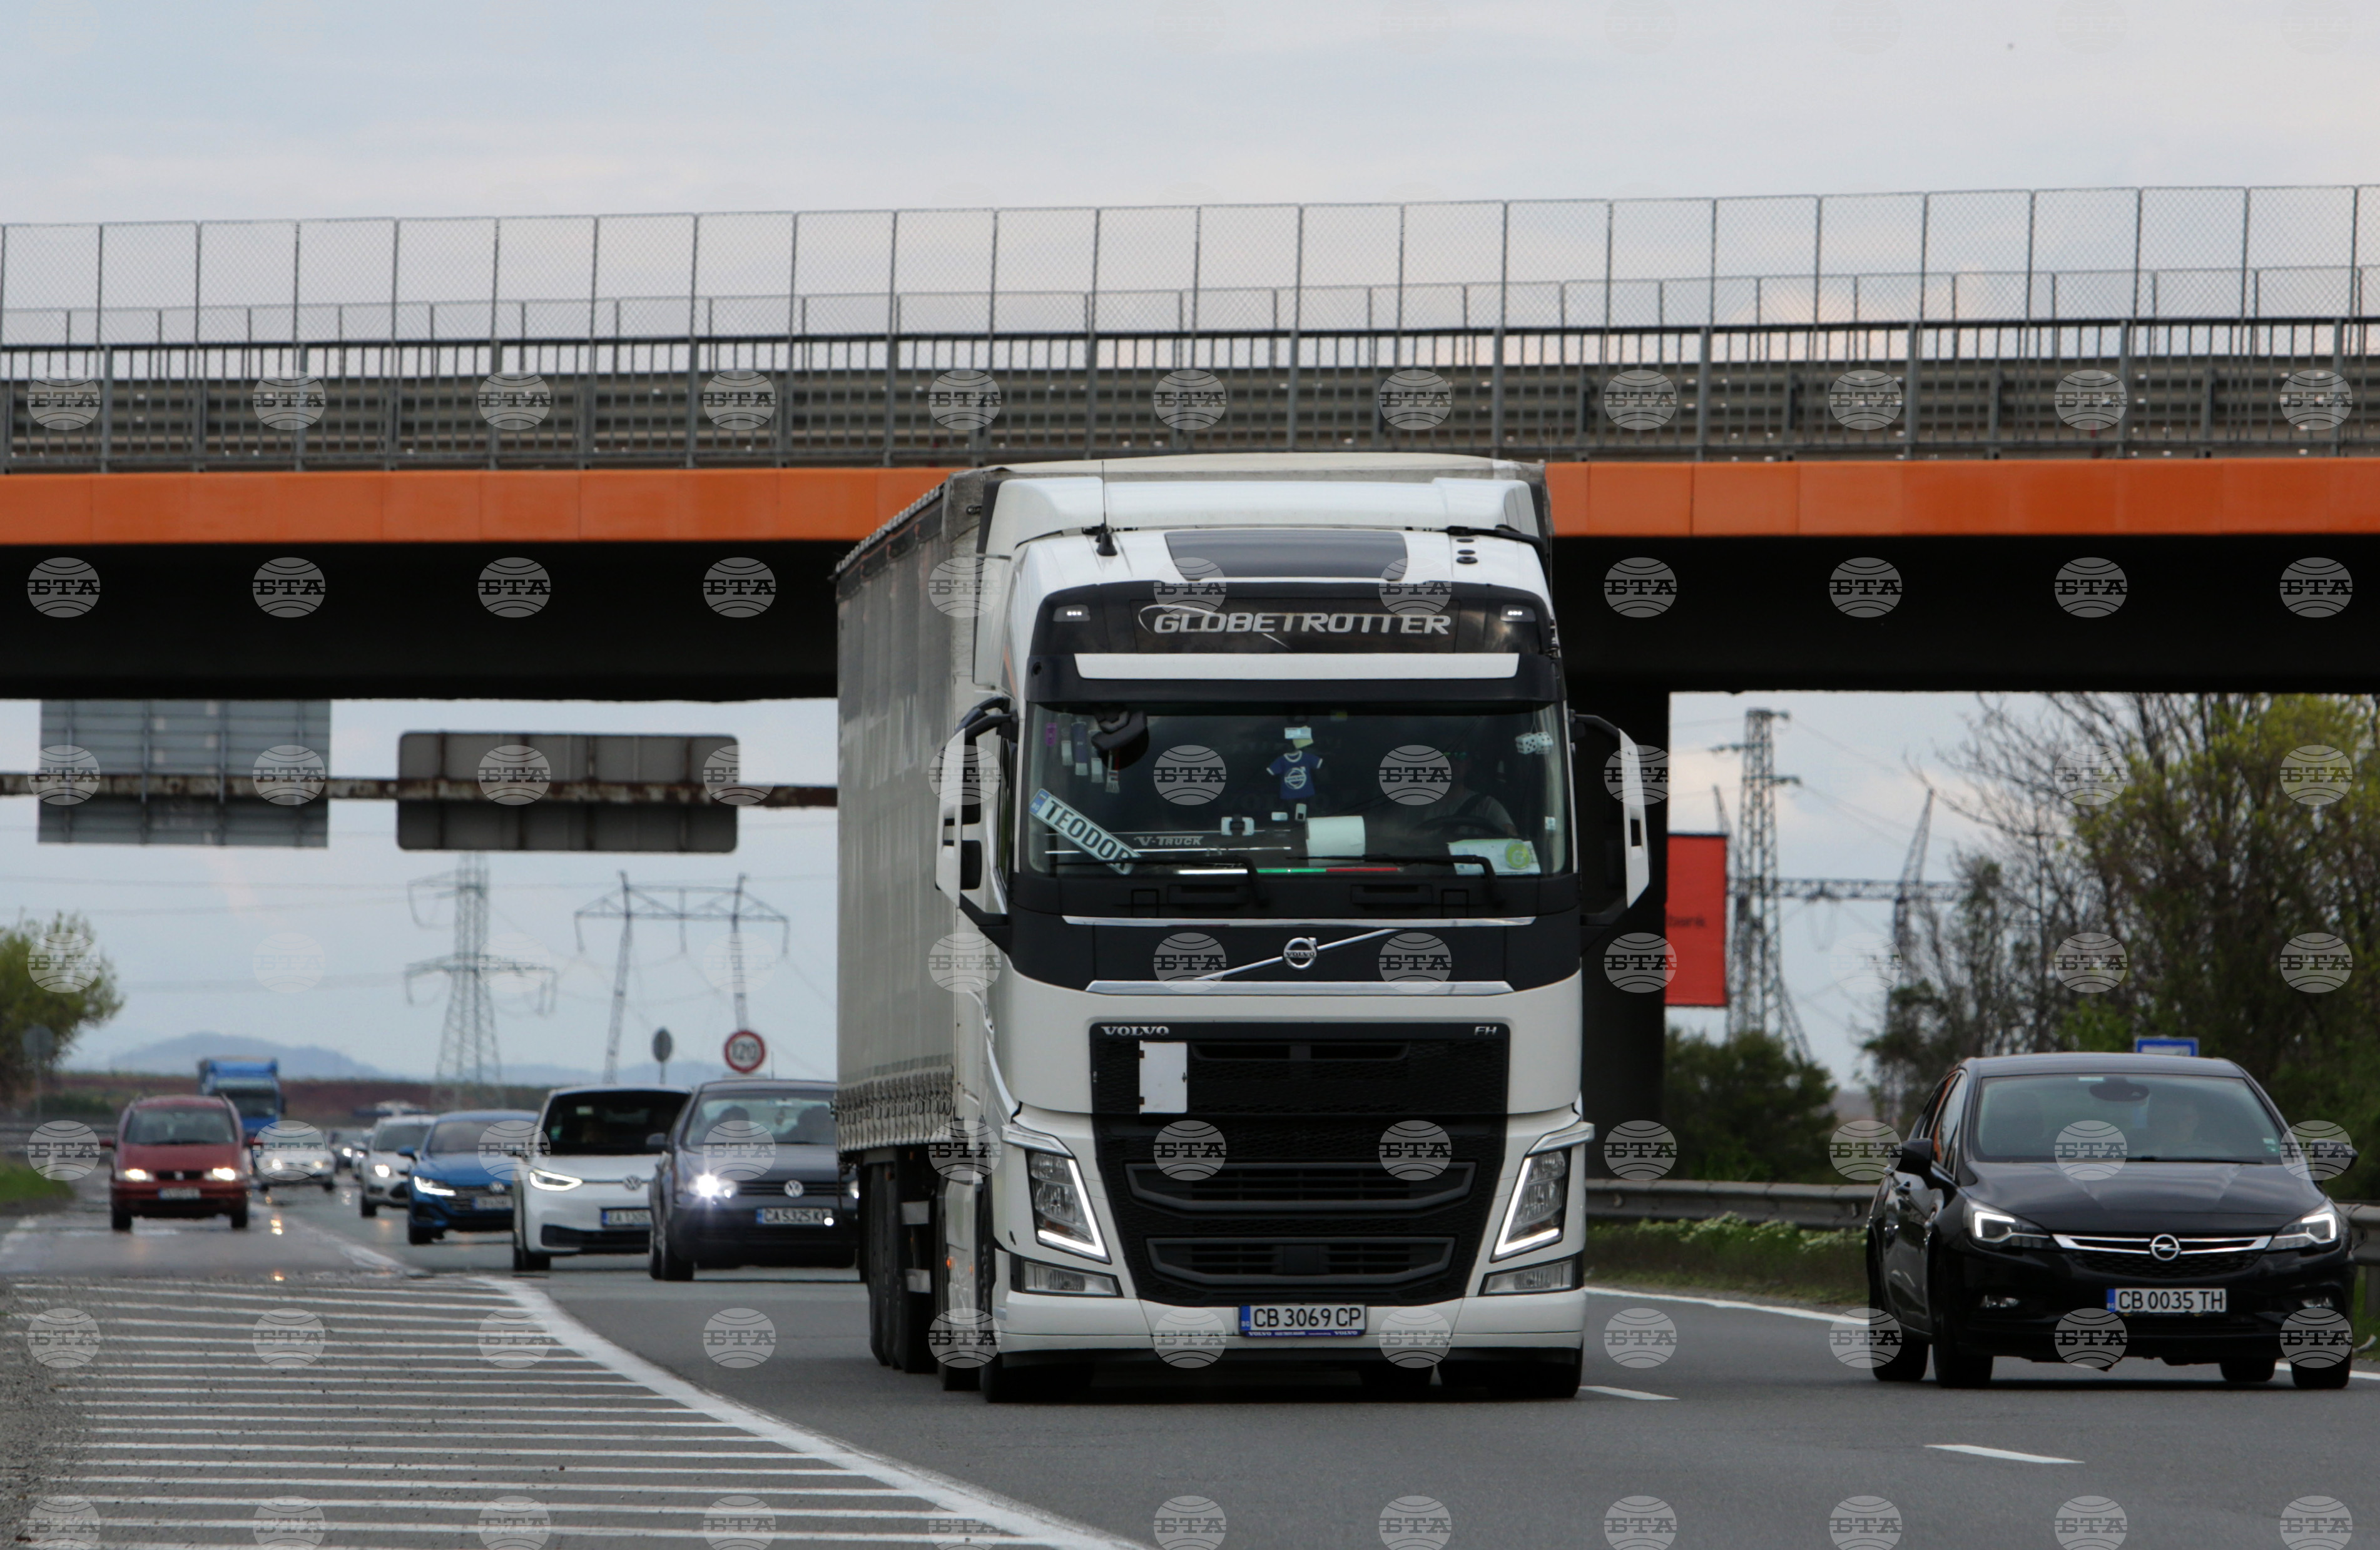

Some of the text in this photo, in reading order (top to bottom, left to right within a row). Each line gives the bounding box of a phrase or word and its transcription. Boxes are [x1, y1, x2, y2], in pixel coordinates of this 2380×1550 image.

[1154, 612, 1450, 634] GLOBETROTTER
[1044, 799, 1133, 871] TEODOR
[1101, 1026, 1169, 1036] VOLVO
[1474, 1026, 1497, 1036] FH
[731, 1041, 758, 1061] 120
[2118, 1291, 2223, 1310] CB 0035 TH
[1254, 1307, 1361, 1327] CB 3069 CP
